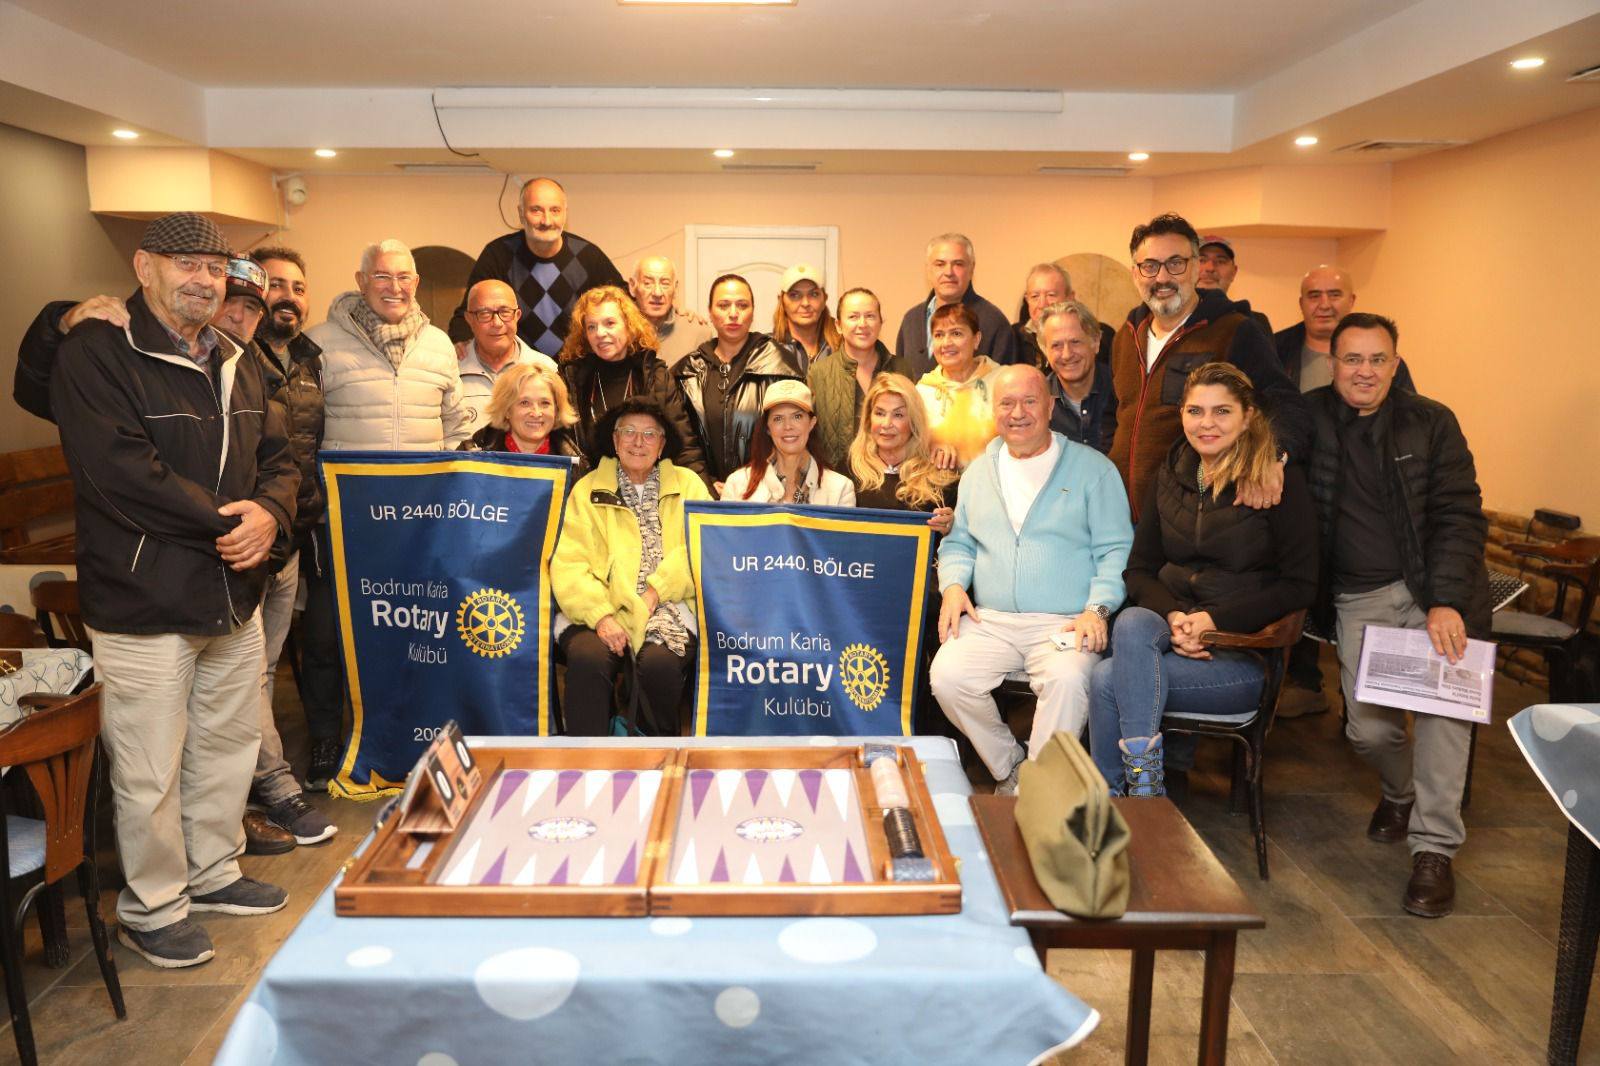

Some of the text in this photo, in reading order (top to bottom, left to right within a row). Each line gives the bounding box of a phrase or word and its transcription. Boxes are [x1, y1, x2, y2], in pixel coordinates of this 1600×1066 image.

[369, 499, 509, 522] UR 2440. BÖLGE
[732, 555, 875, 579] UR 2440. BÖLGE
[361, 578, 449, 599] Bodrum Karia
[477, 596, 504, 606] ROTARY
[371, 600, 449, 639] Rotary
[716, 632, 831, 651] Bodrum Karia
[408, 642, 447, 664] Kulübü
[727, 654, 833, 692] Rotary
[764, 696, 831, 718] Kulübü
